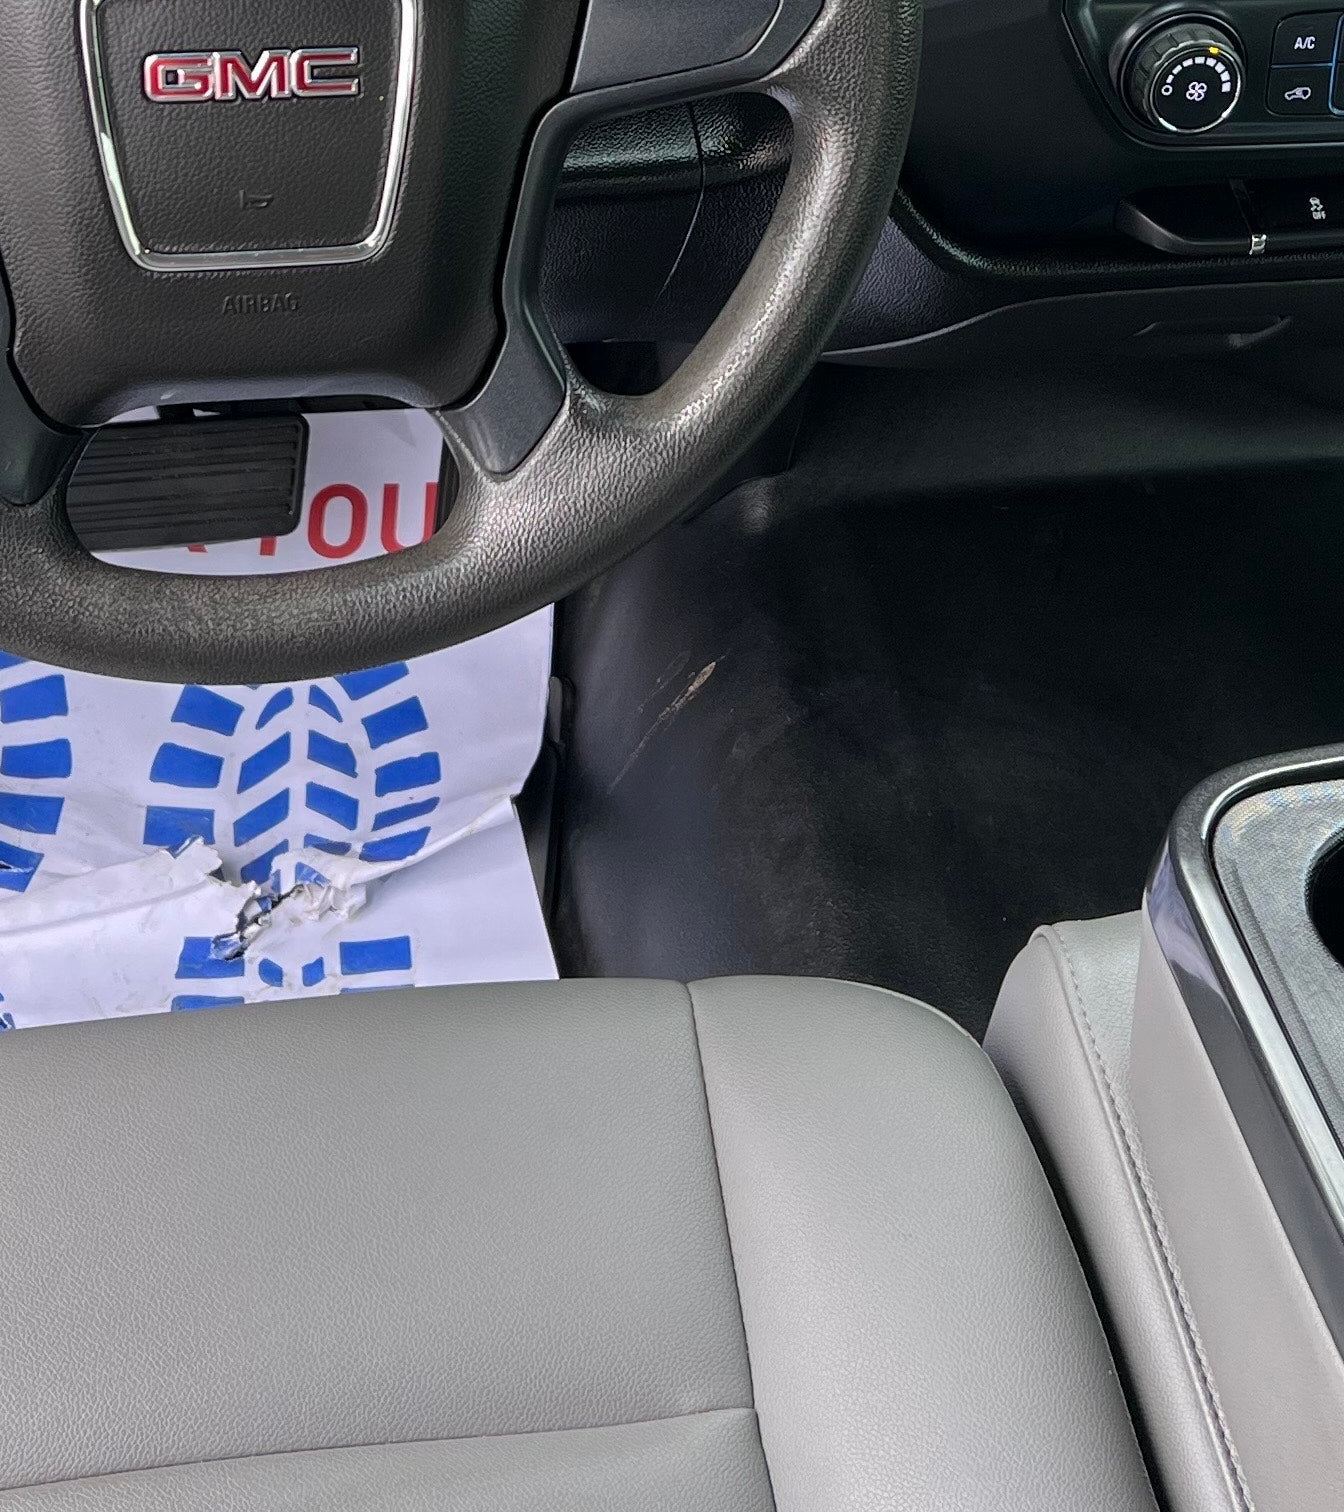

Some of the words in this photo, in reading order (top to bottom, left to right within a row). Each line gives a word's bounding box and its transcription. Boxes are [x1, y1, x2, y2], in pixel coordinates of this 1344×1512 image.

[1294, 36, 1316, 50] A/C
[144, 46, 360, 103] GMC
[221, 292, 300, 314] AIRBAG
[259, 482, 440, 559] OU
